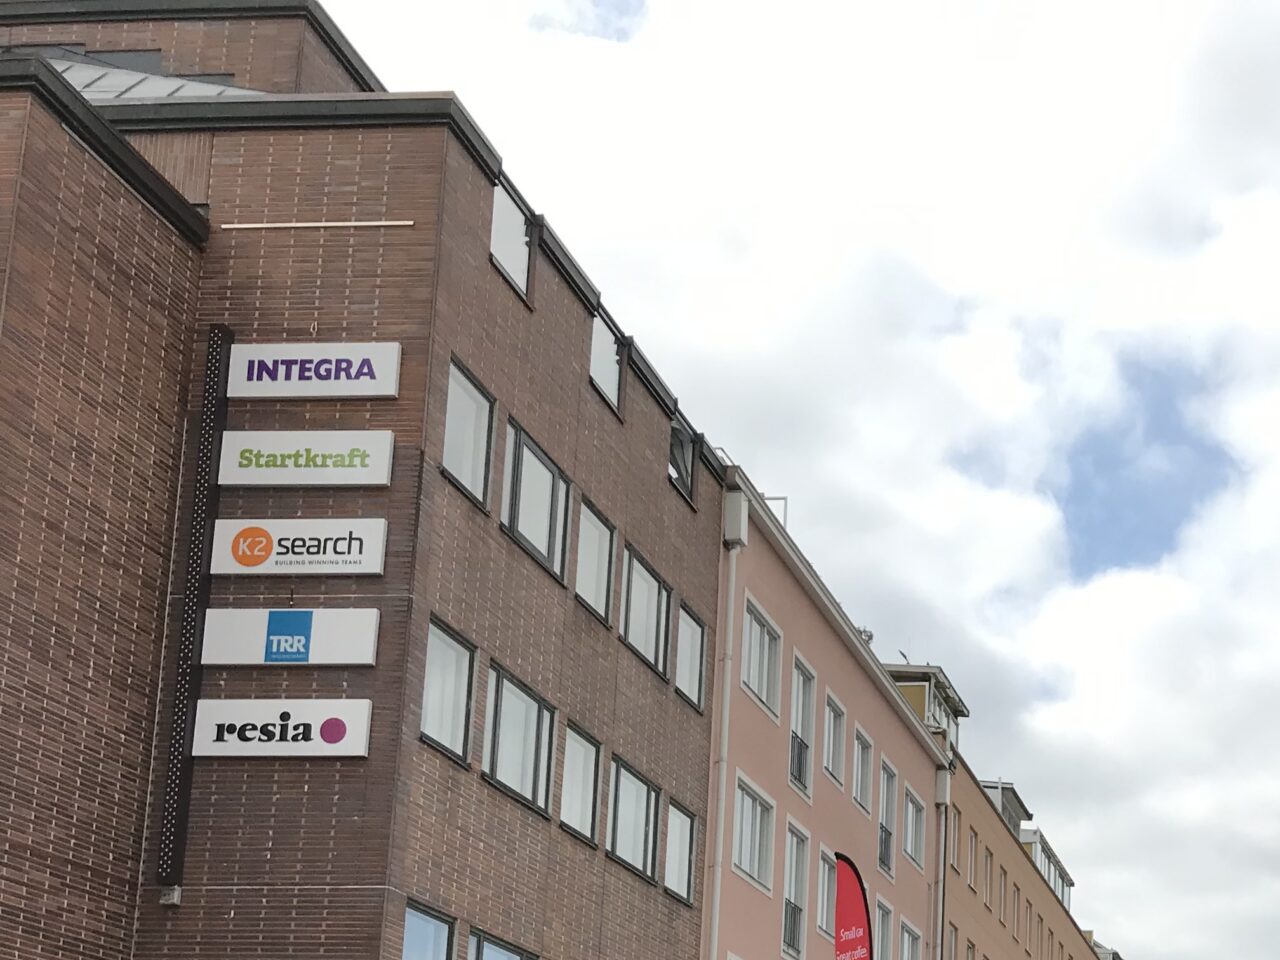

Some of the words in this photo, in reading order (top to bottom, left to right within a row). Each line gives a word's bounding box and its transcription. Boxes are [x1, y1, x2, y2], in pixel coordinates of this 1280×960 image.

[246, 358, 377, 382] INTEGRA
[238, 447, 371, 469] Startkraft
[238, 537, 266, 556] K2
[275, 530, 364, 556] search
[269, 635, 306, 653] TRR
[213, 710, 313, 743] resia
